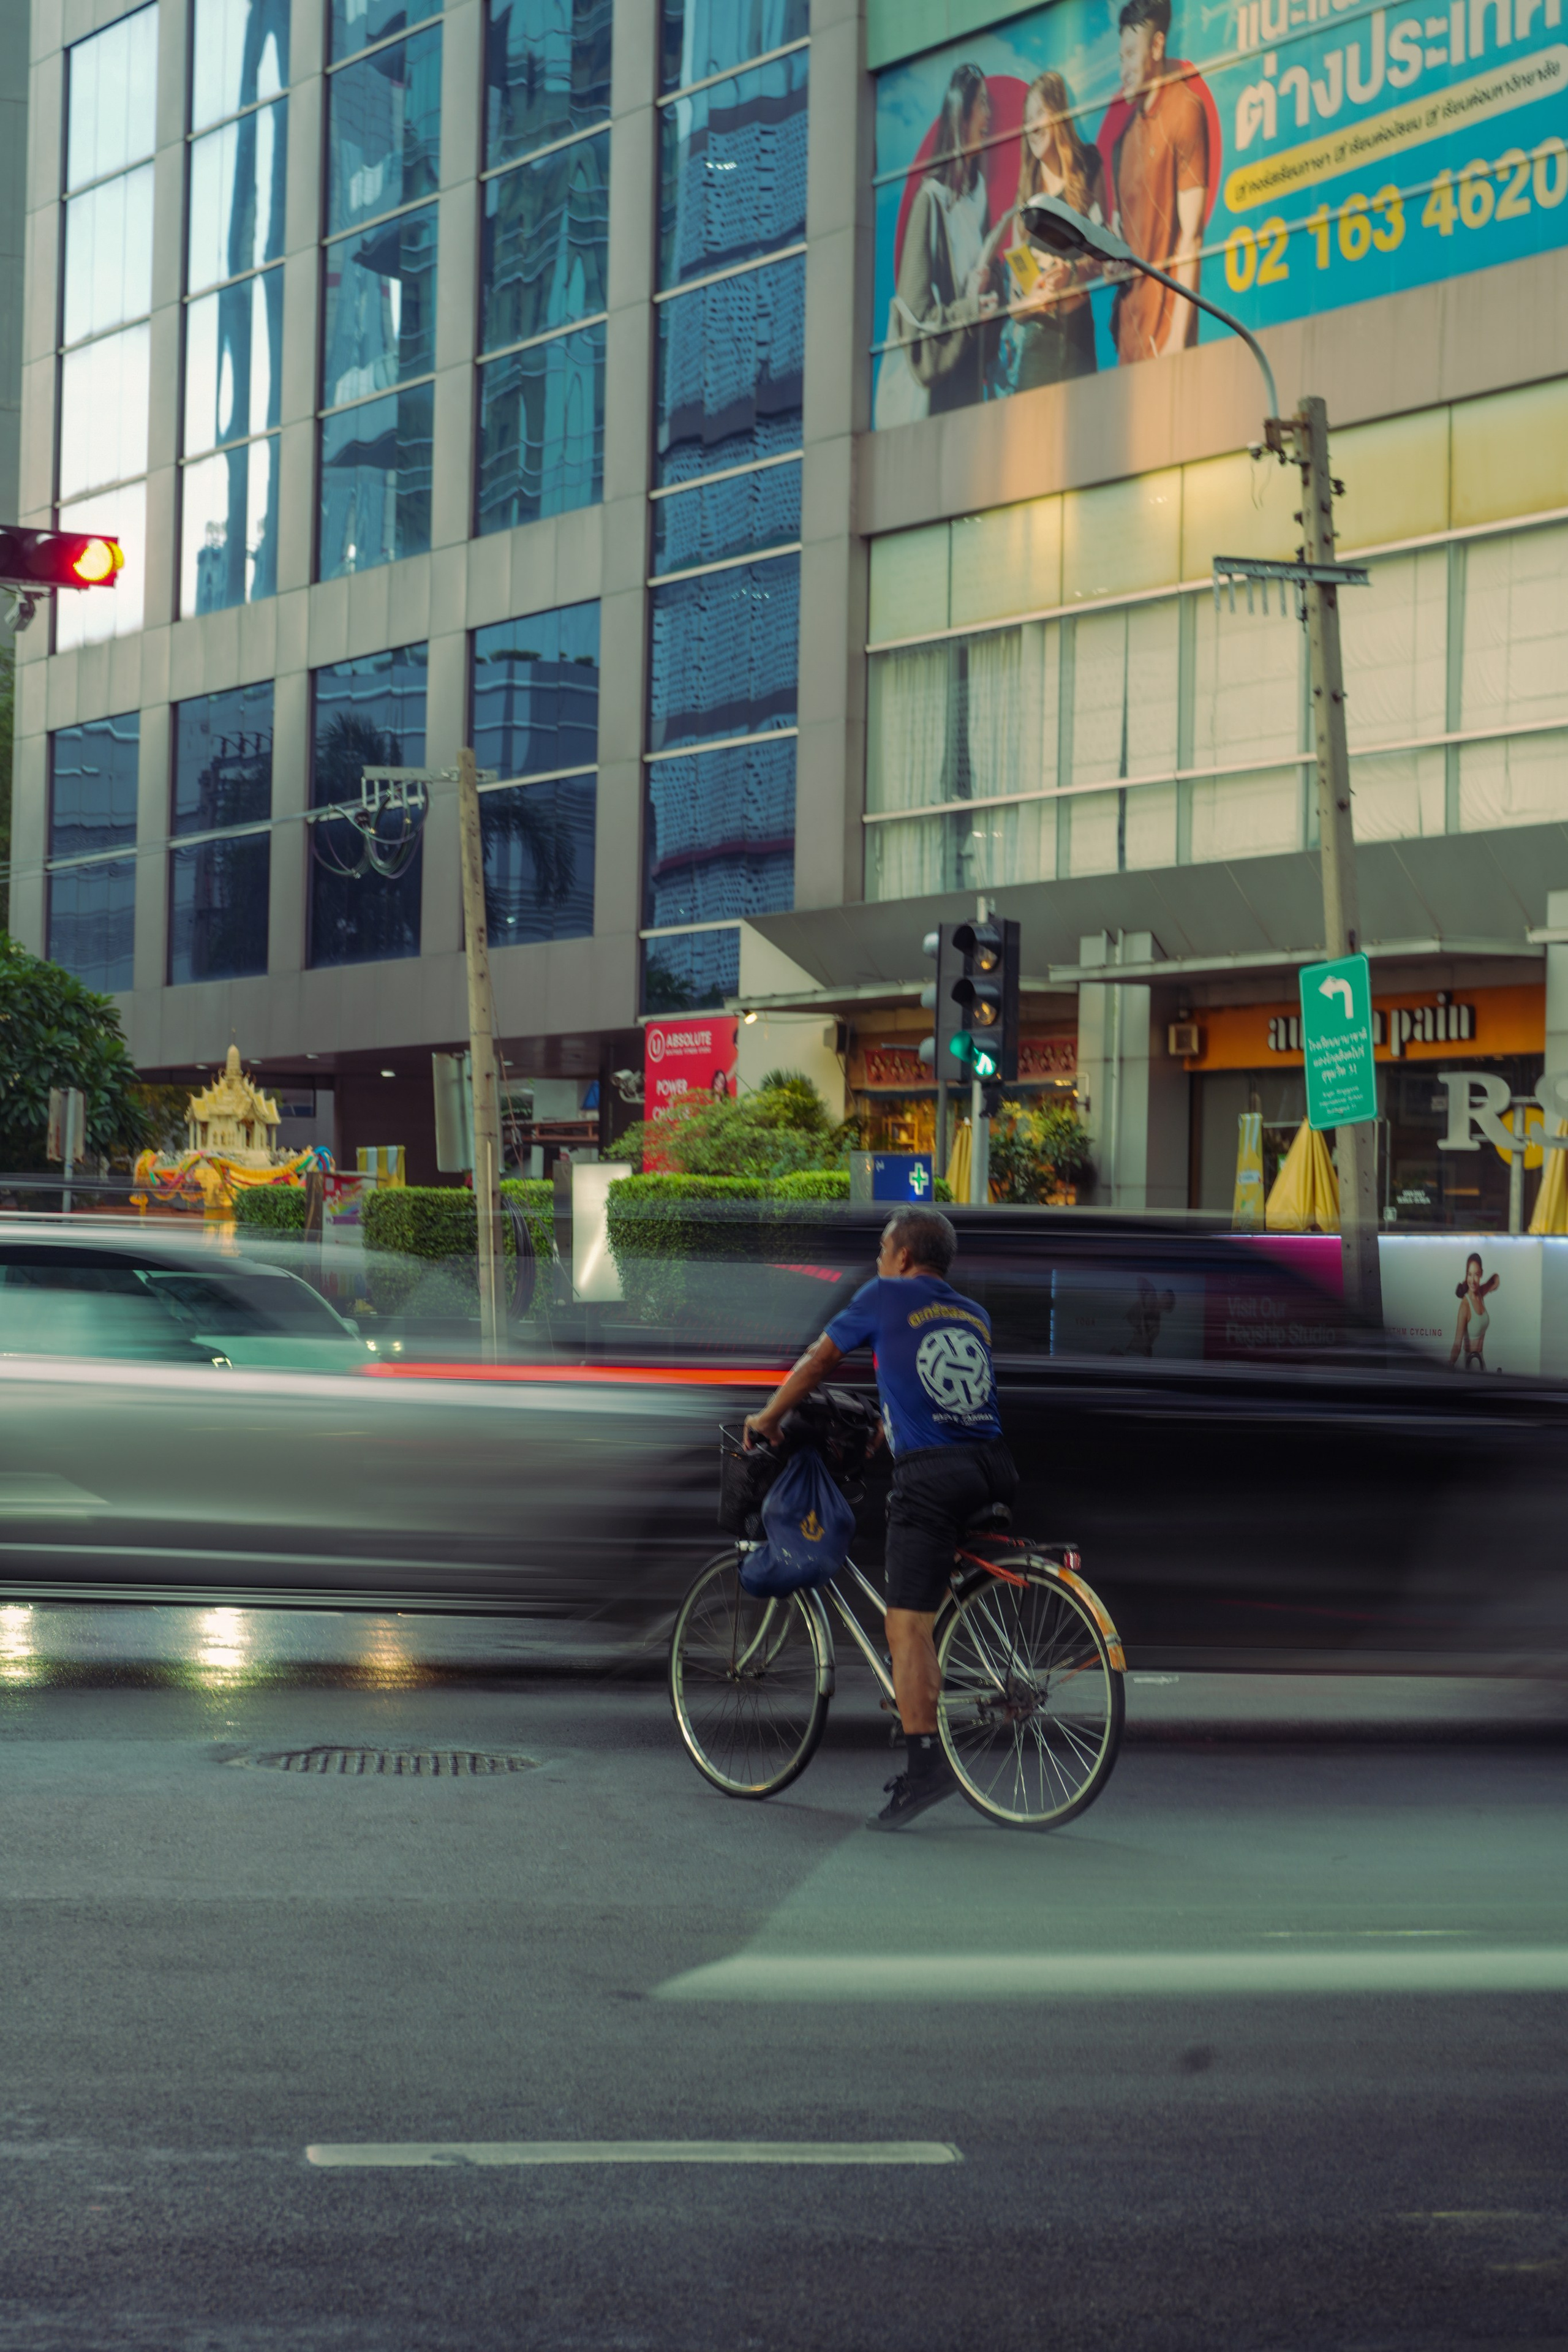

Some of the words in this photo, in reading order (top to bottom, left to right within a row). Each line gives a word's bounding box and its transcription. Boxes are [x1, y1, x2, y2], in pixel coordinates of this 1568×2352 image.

[1225, 217, 1289, 292] 02
[1306, 184, 1406, 270] 163
[1421, 136, 1567, 236] 4620
[1390, 992, 1469, 1057] pain
[666, 1031, 712, 1048] ABSOLUTE
[656, 1079, 687, 1096] POWER
[1227, 1295, 1257, 1317] Visit
[1287, 1321, 1336, 1345] Studio
[1410, 1328, 1442, 1336] CYCLING
